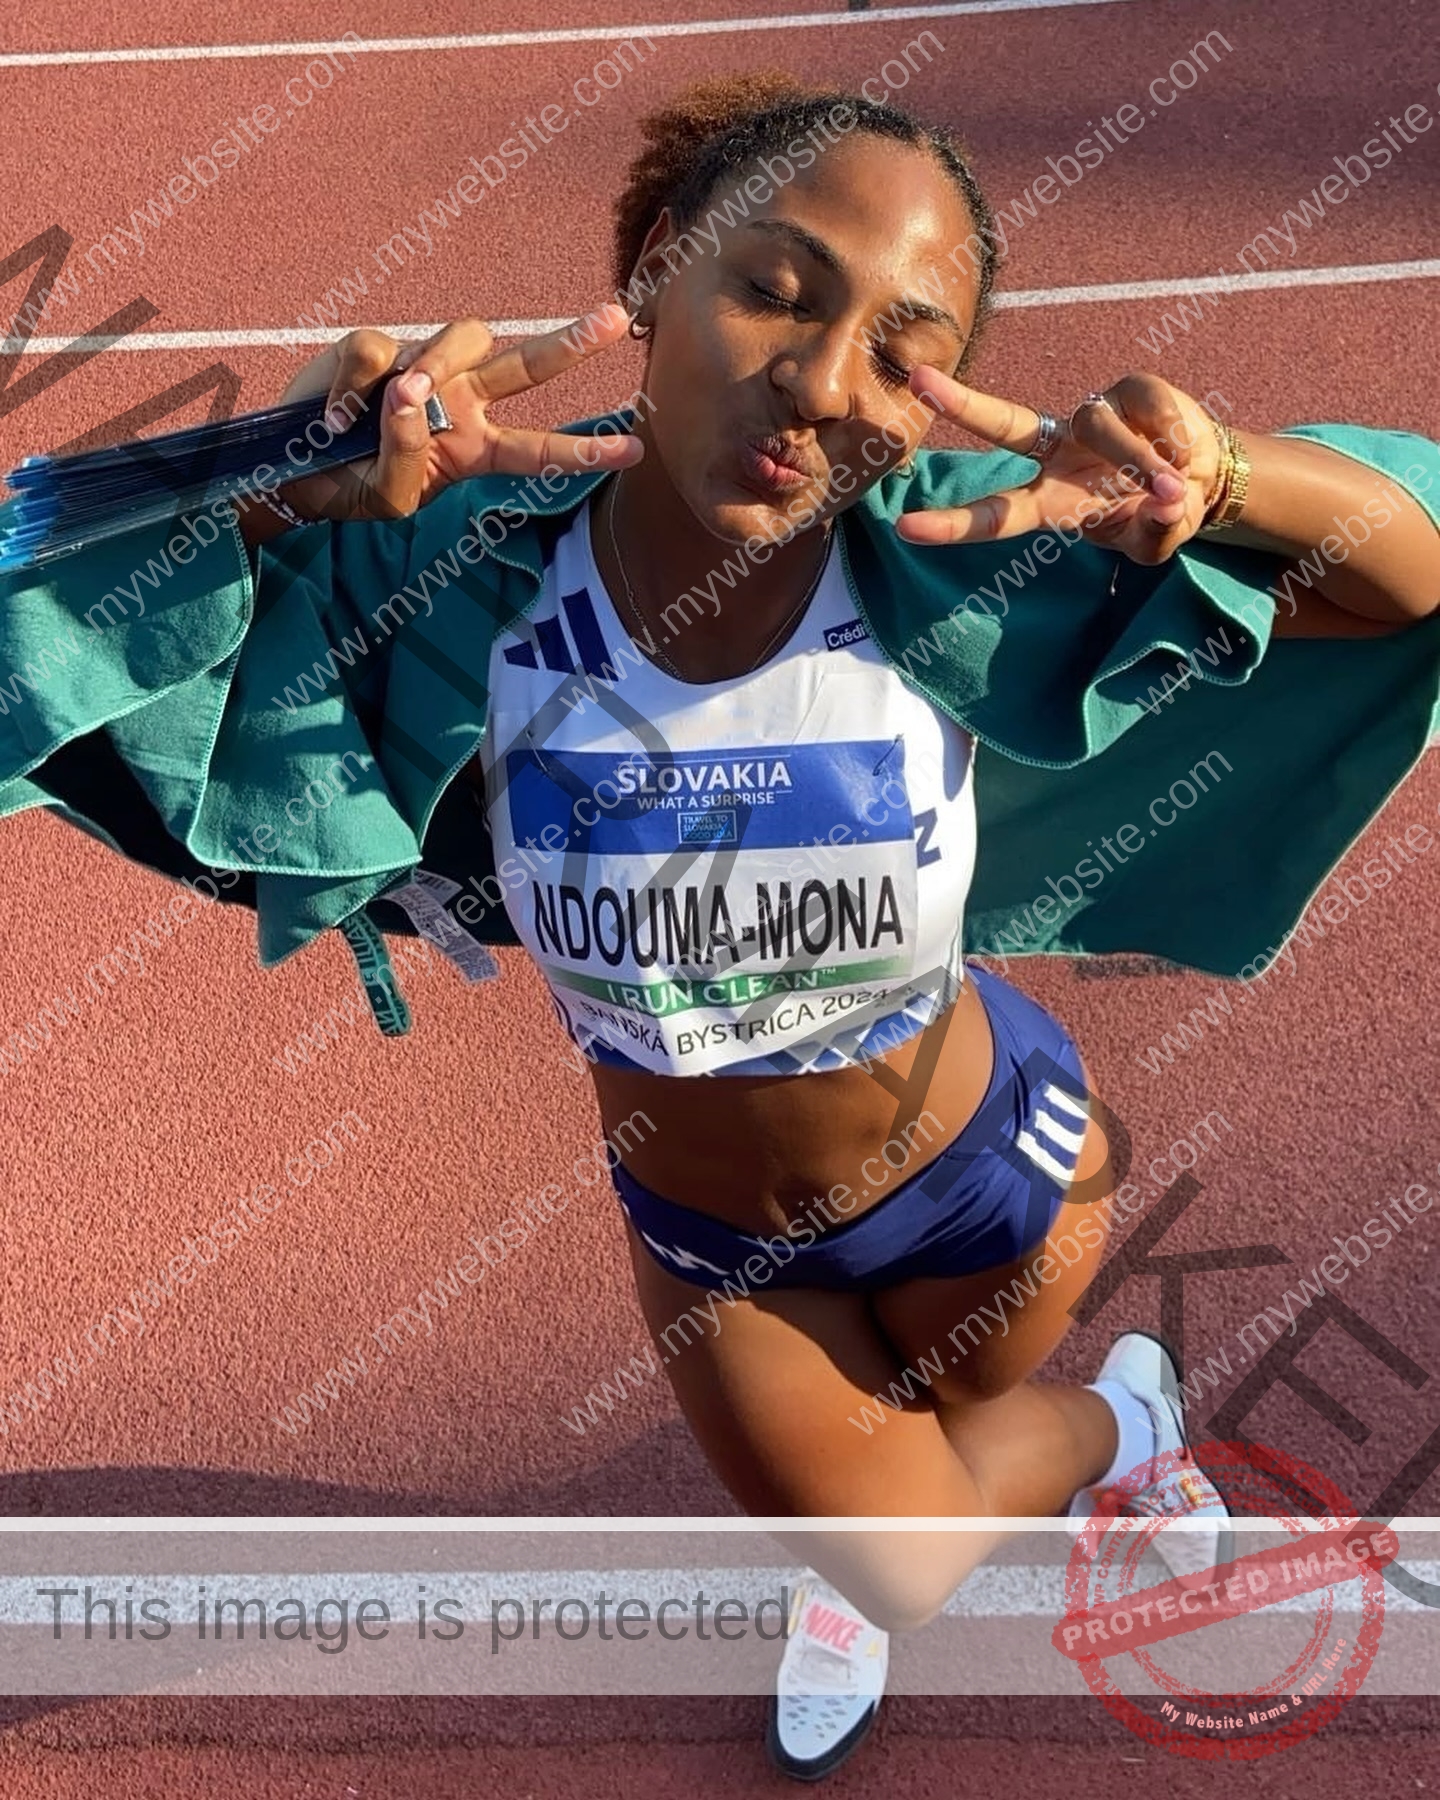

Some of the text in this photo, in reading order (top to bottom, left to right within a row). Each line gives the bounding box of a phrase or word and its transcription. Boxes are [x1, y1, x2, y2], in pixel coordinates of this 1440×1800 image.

[826, 624, 866, 649] Crédi
[617, 761, 792, 794] SLOVAKIA
[637, 791, 776, 810] WHAT A SURPRISE
[532, 875, 903, 968] NDOUMA-MONA
[607, 983, 617, 1003] I
[622, 980, 694, 1013] RUN
[677, 1003, 816, 1056] BYSTRICA
[821, 988, 889, 1016] 2024
[804, 1602, 864, 1654] NIKE
